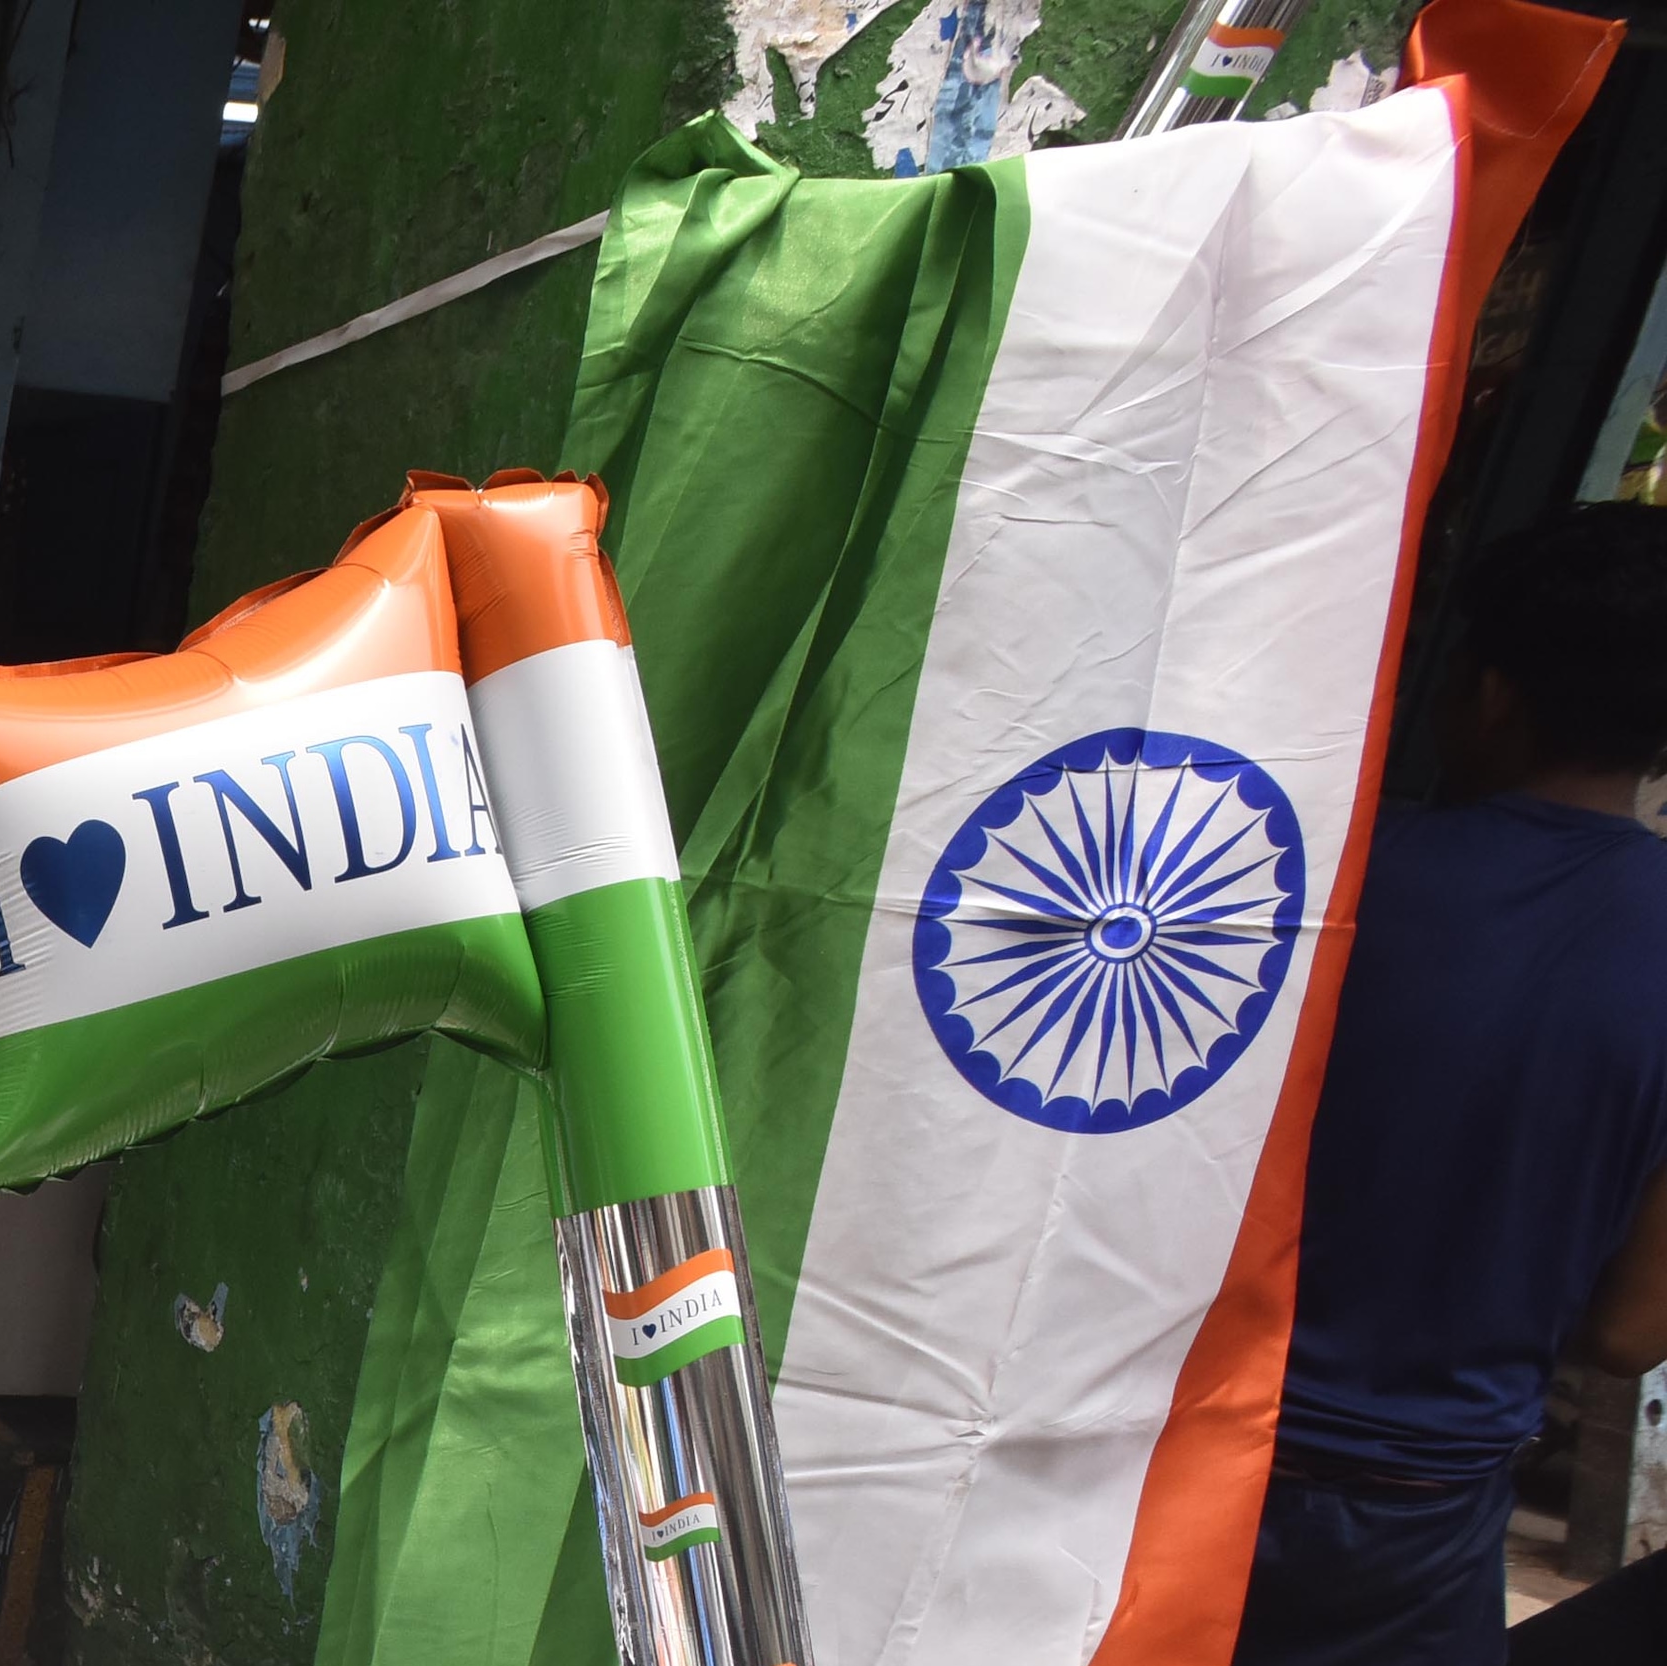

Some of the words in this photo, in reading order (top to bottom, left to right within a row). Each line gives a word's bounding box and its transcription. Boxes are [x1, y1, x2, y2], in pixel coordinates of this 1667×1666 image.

[1210, 54, 1220, 67] I
[631, 1327, 640, 1346] I
[658, 1288, 723, 1333] INDIA
[651, 1531, 657, 1542] I
[664, 1513, 702, 1537] INDIA
